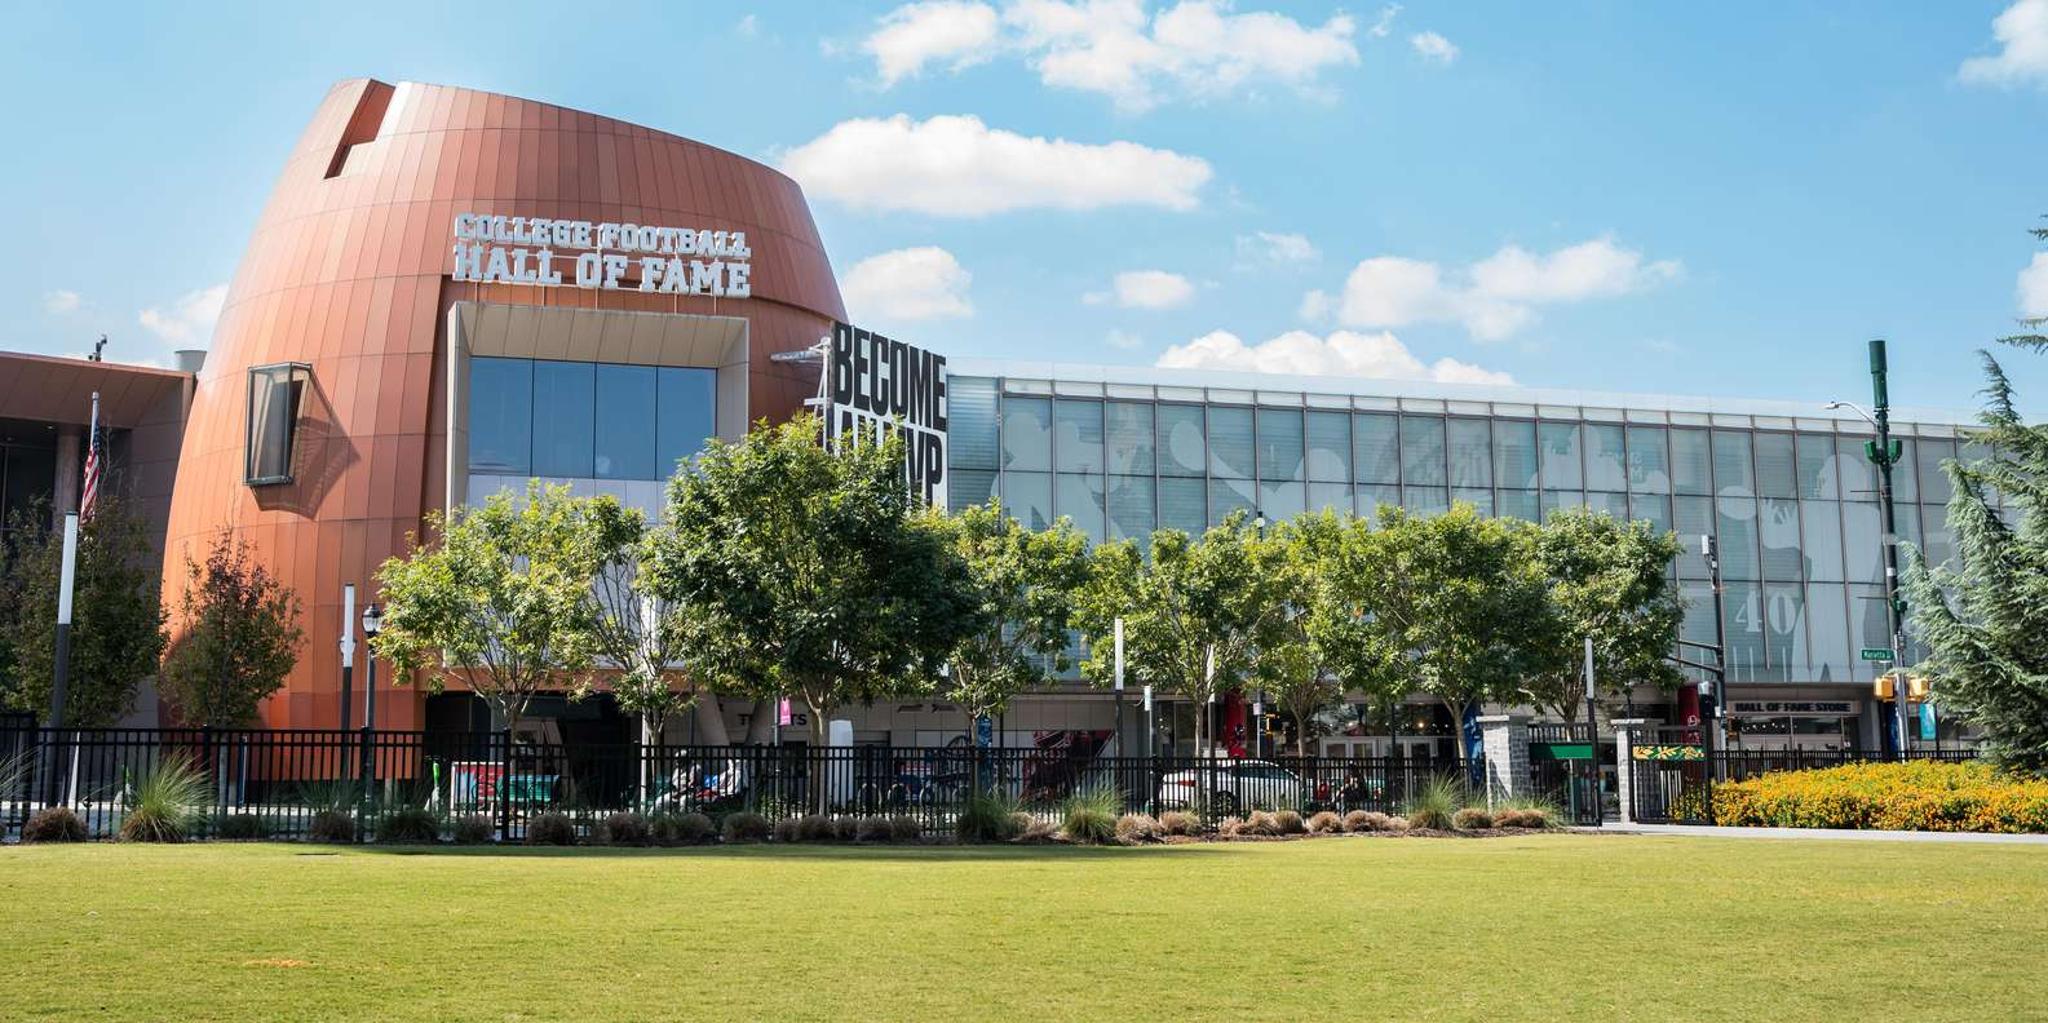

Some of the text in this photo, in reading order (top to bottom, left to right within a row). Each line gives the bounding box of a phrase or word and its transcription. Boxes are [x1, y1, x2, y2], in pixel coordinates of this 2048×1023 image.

[455, 213, 751, 258] COLLEGE FOOTBALL
[452, 244, 751, 298] HALL OF FAME
[834, 321, 946, 432] BECOME
[1735, 590, 1796, 634] 40
[1735, 702, 1851, 714] HALL OF FAME STORE
